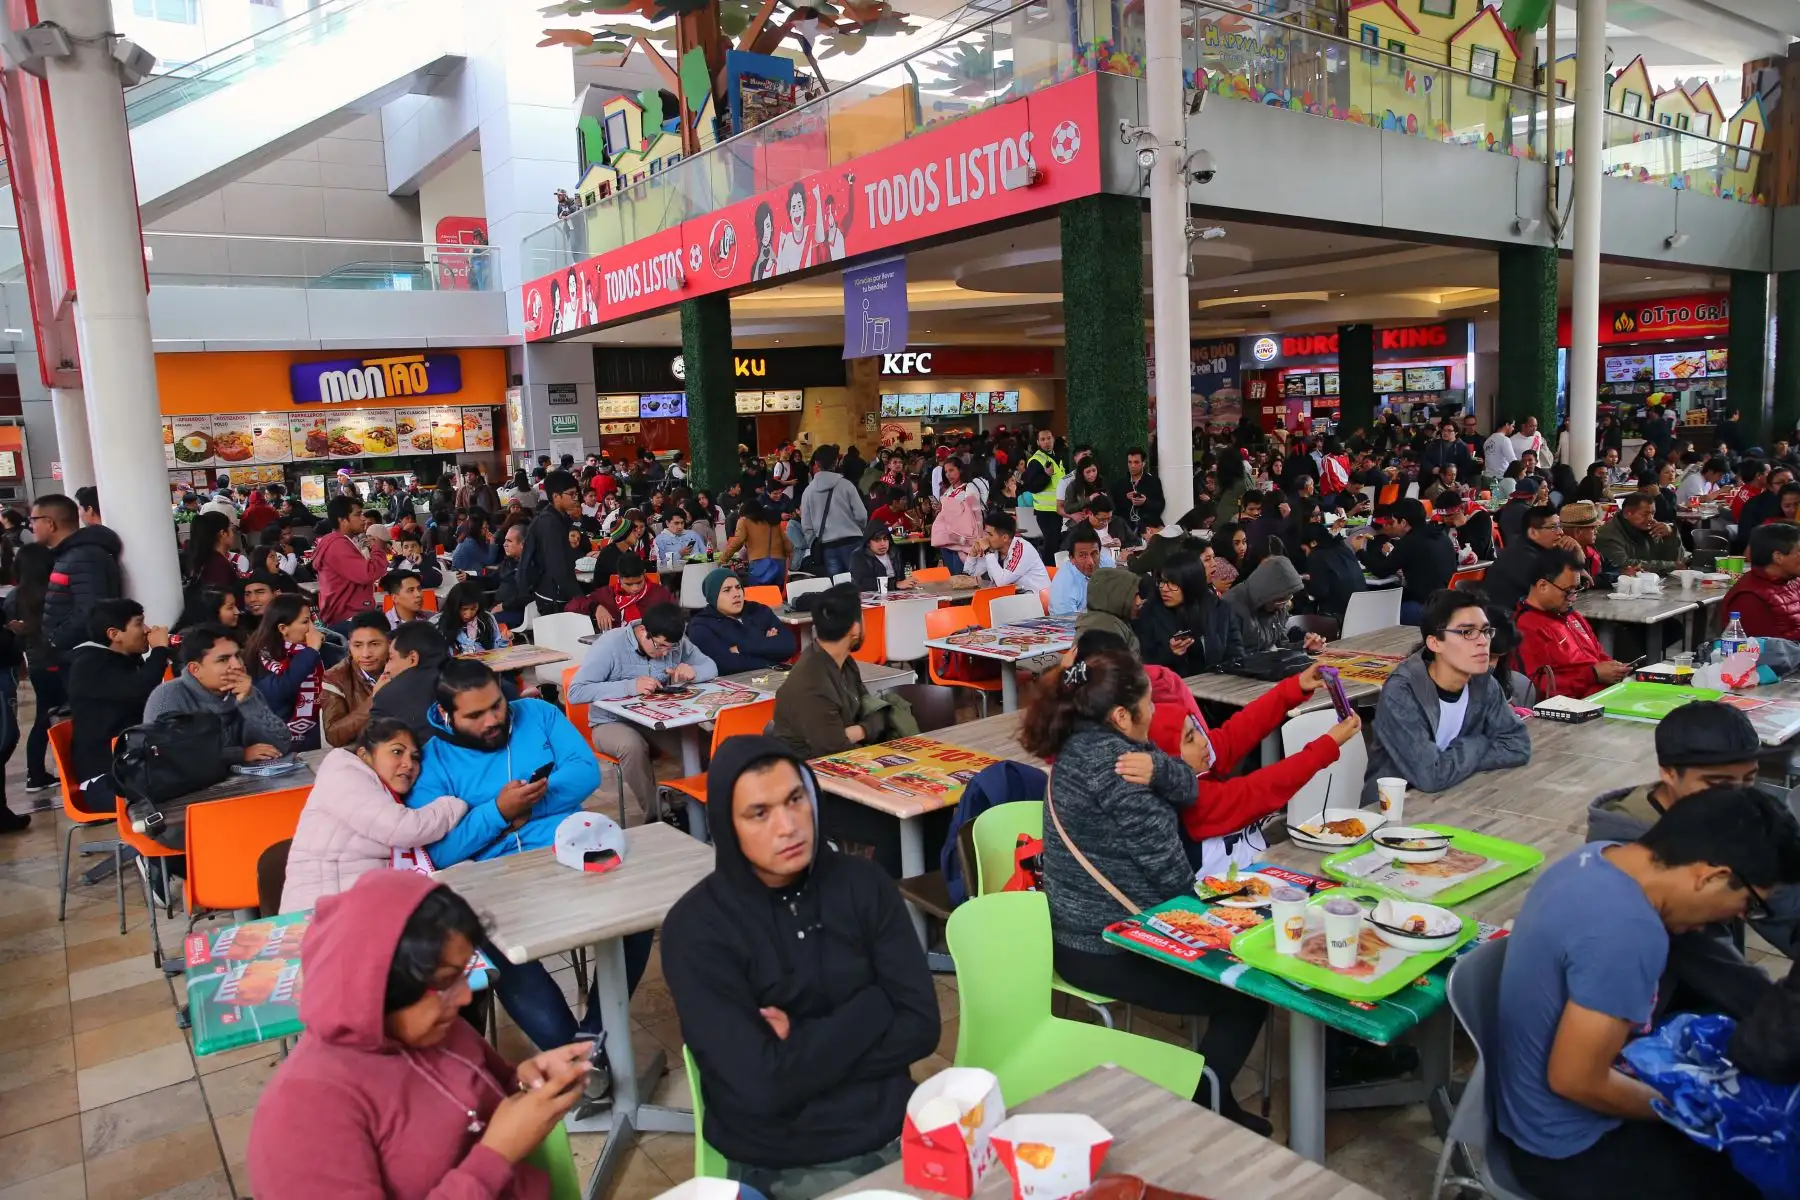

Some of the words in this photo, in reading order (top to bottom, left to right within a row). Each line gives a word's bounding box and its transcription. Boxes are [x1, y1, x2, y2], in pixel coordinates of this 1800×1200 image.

[864, 162, 940, 229] TODOS
[945, 131, 1037, 207] LISTOS
[604, 263, 641, 305] TODOS
[642, 248, 685, 294] LISTOS
[1640, 304, 1690, 325] OTTO
[1282, 332, 1376, 357] BURG
[1382, 326, 1447, 349] KING
[881, 352, 932, 374] KFC
[552, 415, 577, 425] SALIDA
[1130, 929, 1169, 946] AGREGA
